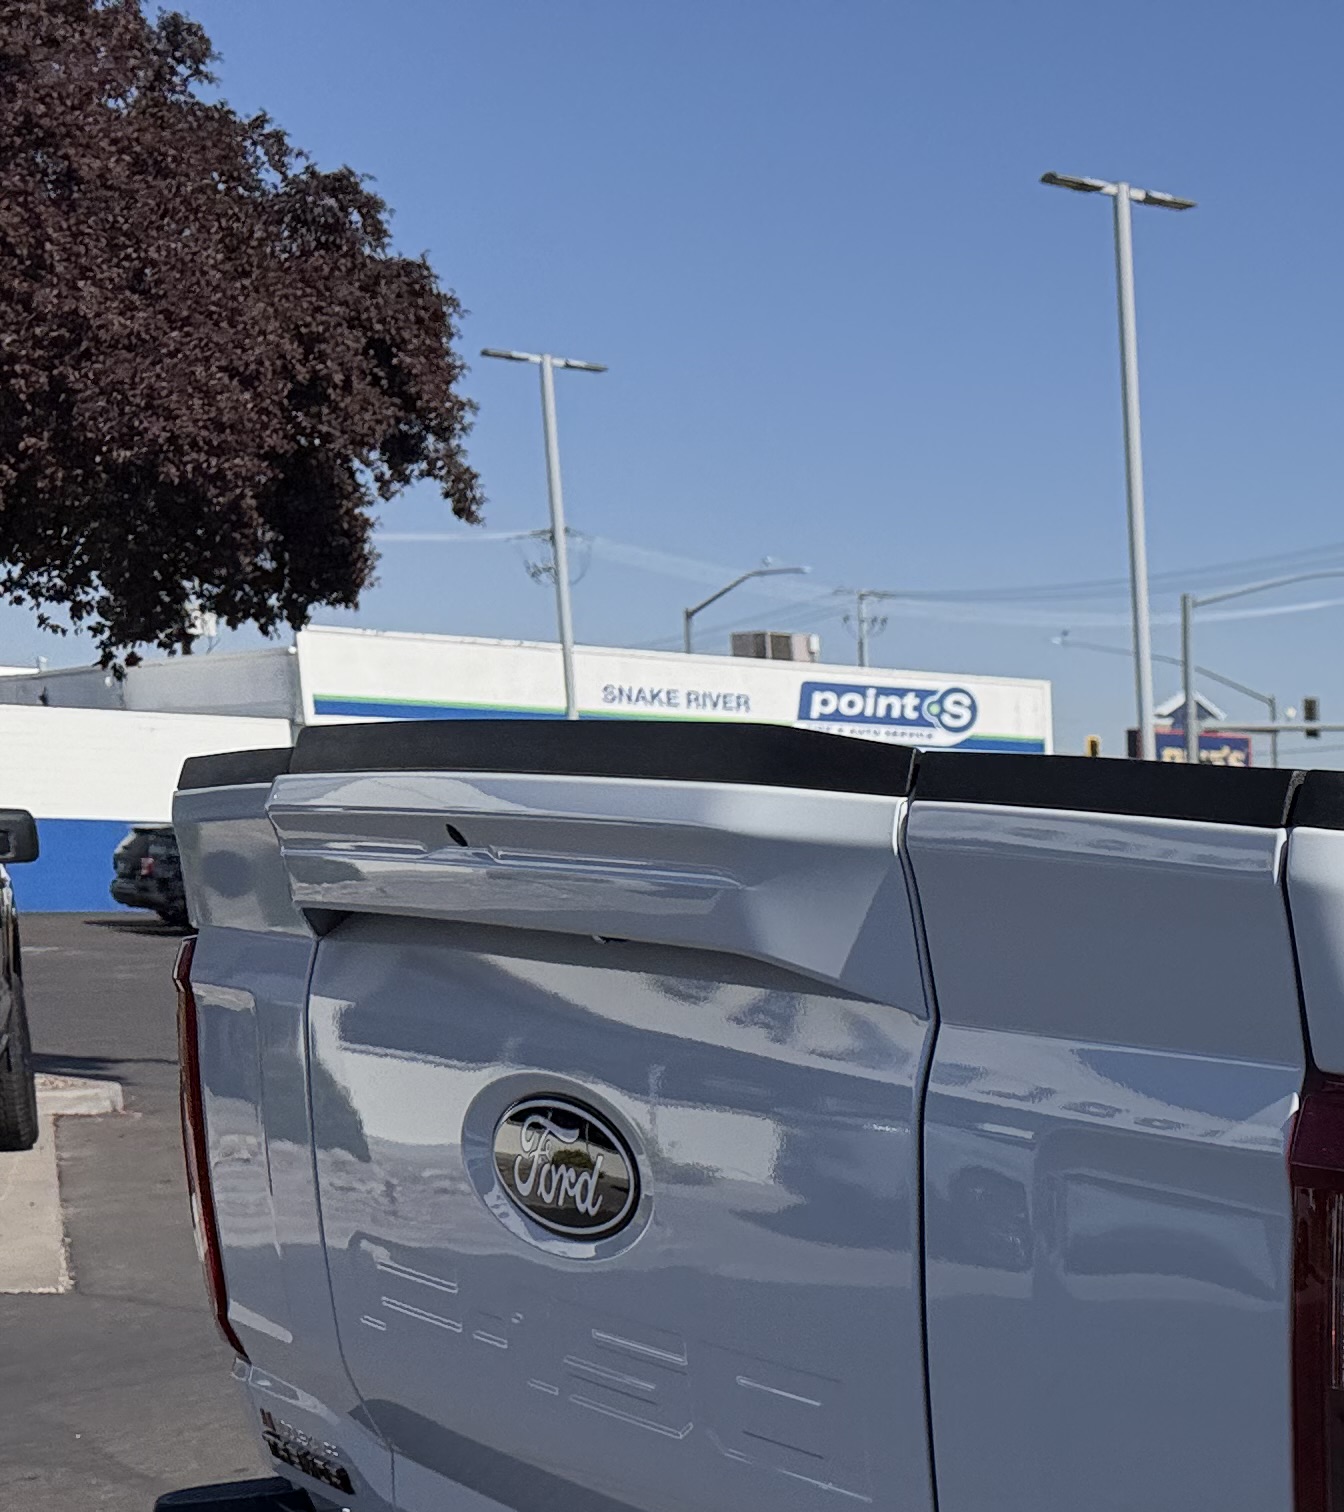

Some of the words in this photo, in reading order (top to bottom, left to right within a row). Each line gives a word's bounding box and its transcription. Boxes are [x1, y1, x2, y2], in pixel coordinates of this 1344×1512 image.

[602, 683, 680, 708] SNAKE
[686, 689, 751, 713] RIVER
[810, 687, 920, 720] point
[940, 692, 972, 728] S
[513, 1113, 604, 1217] Ford
